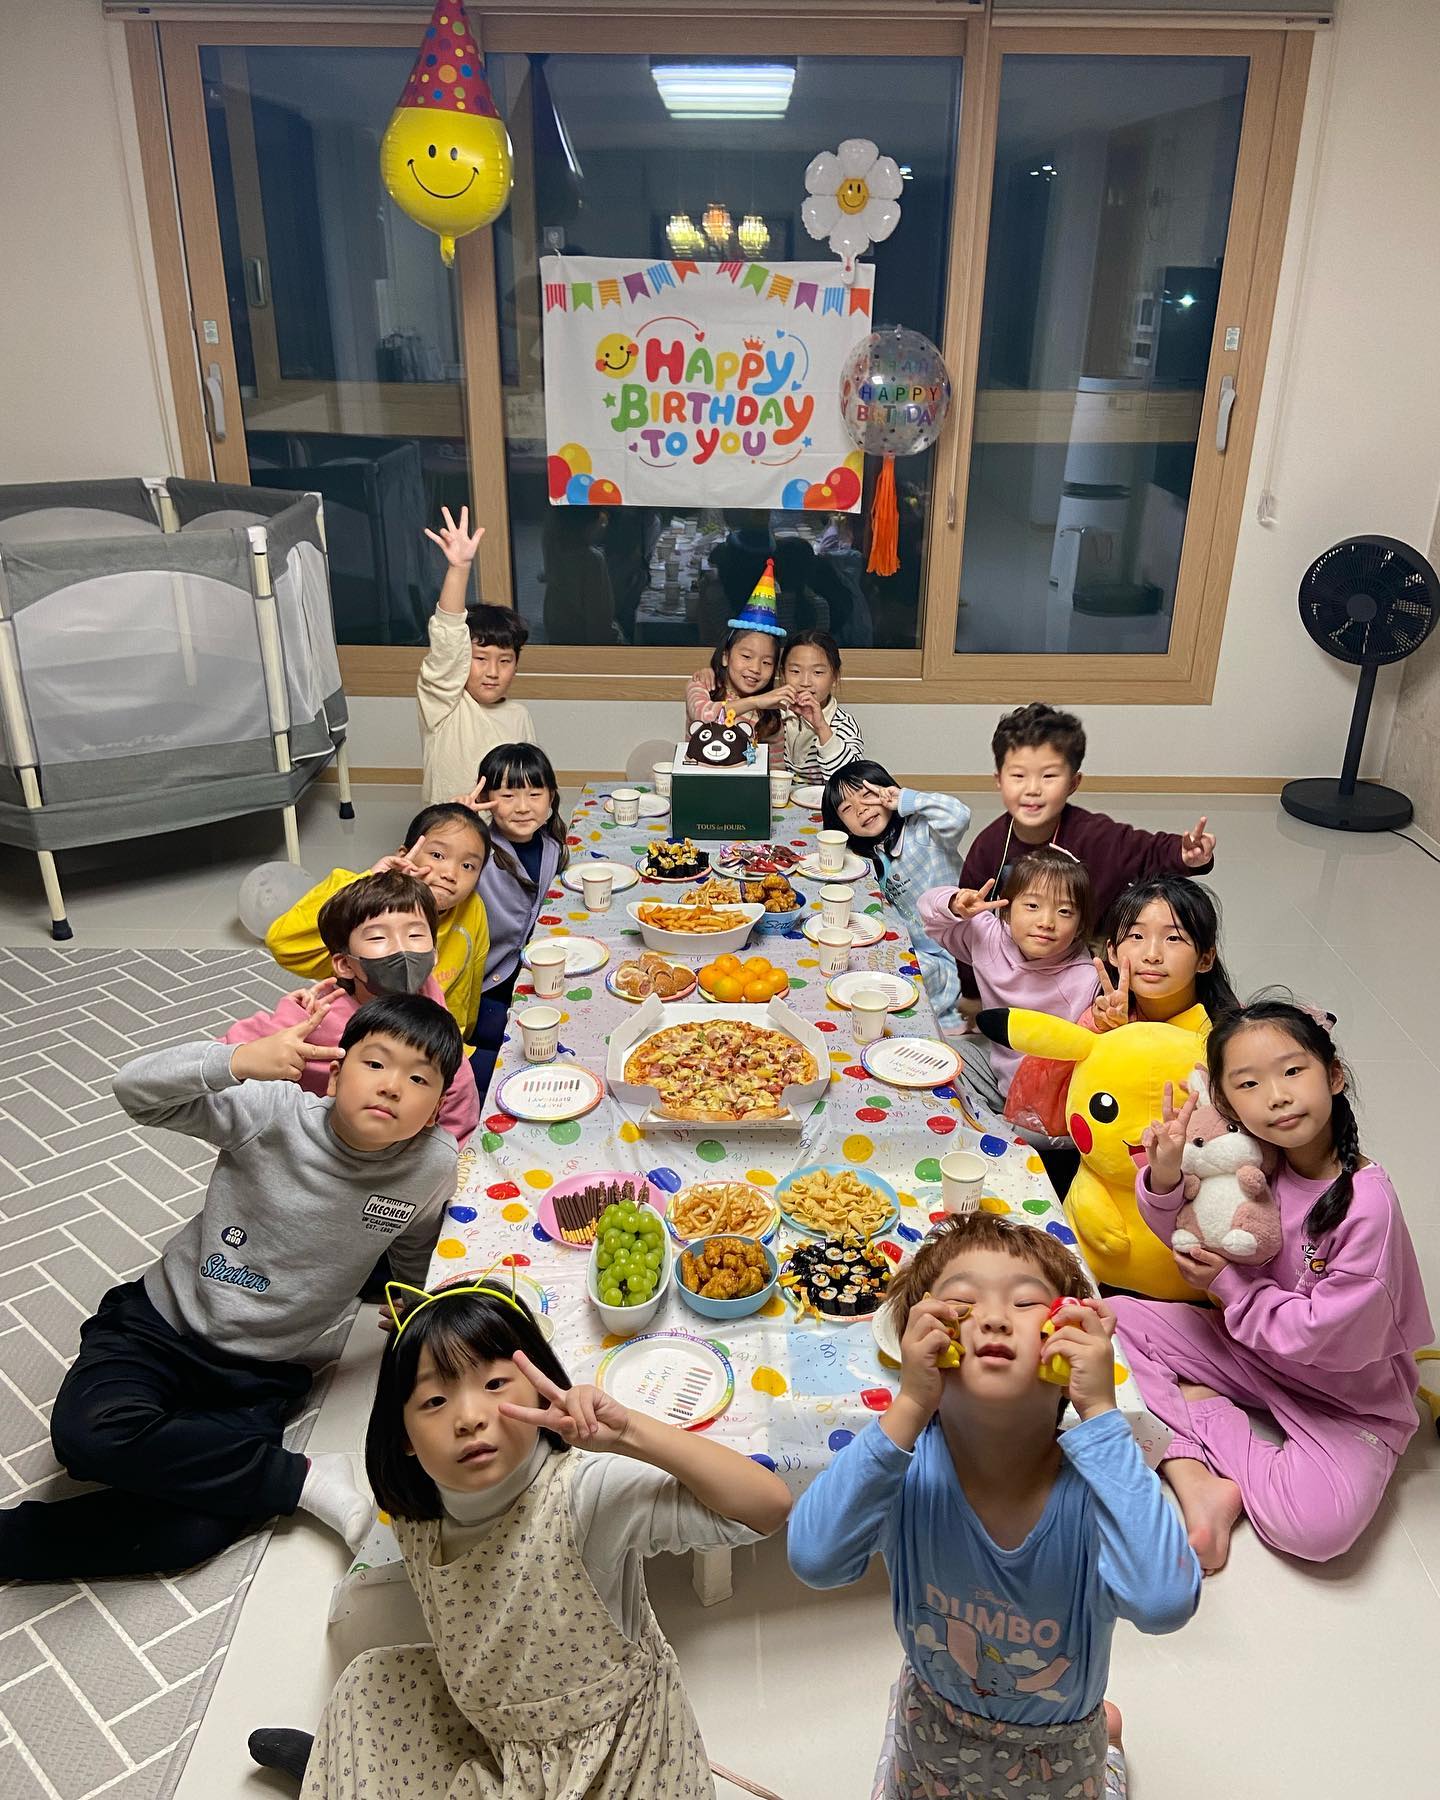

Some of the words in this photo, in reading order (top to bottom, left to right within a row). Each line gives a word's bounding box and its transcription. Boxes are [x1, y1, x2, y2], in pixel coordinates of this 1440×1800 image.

[645, 338, 795, 396] HAPPY
[861, 386, 938, 401] HAPPY
[611, 383, 814, 446] BIRTHDAY
[640, 429, 688, 458] TO
[692, 427, 767, 465] YOU
[696, 823, 716, 831] TOUS
[723, 823, 746, 832] JOURS
[366, 1223, 378, 1231] EST.
[370, 1217, 402, 1229] CALIFORNIA
[225, 1234, 242, 1245] RUN
[229, 1228, 245, 1238] GO!
[200, 1253, 271, 1292] Skechers
[926, 1583, 1061, 1649] DUMBO
